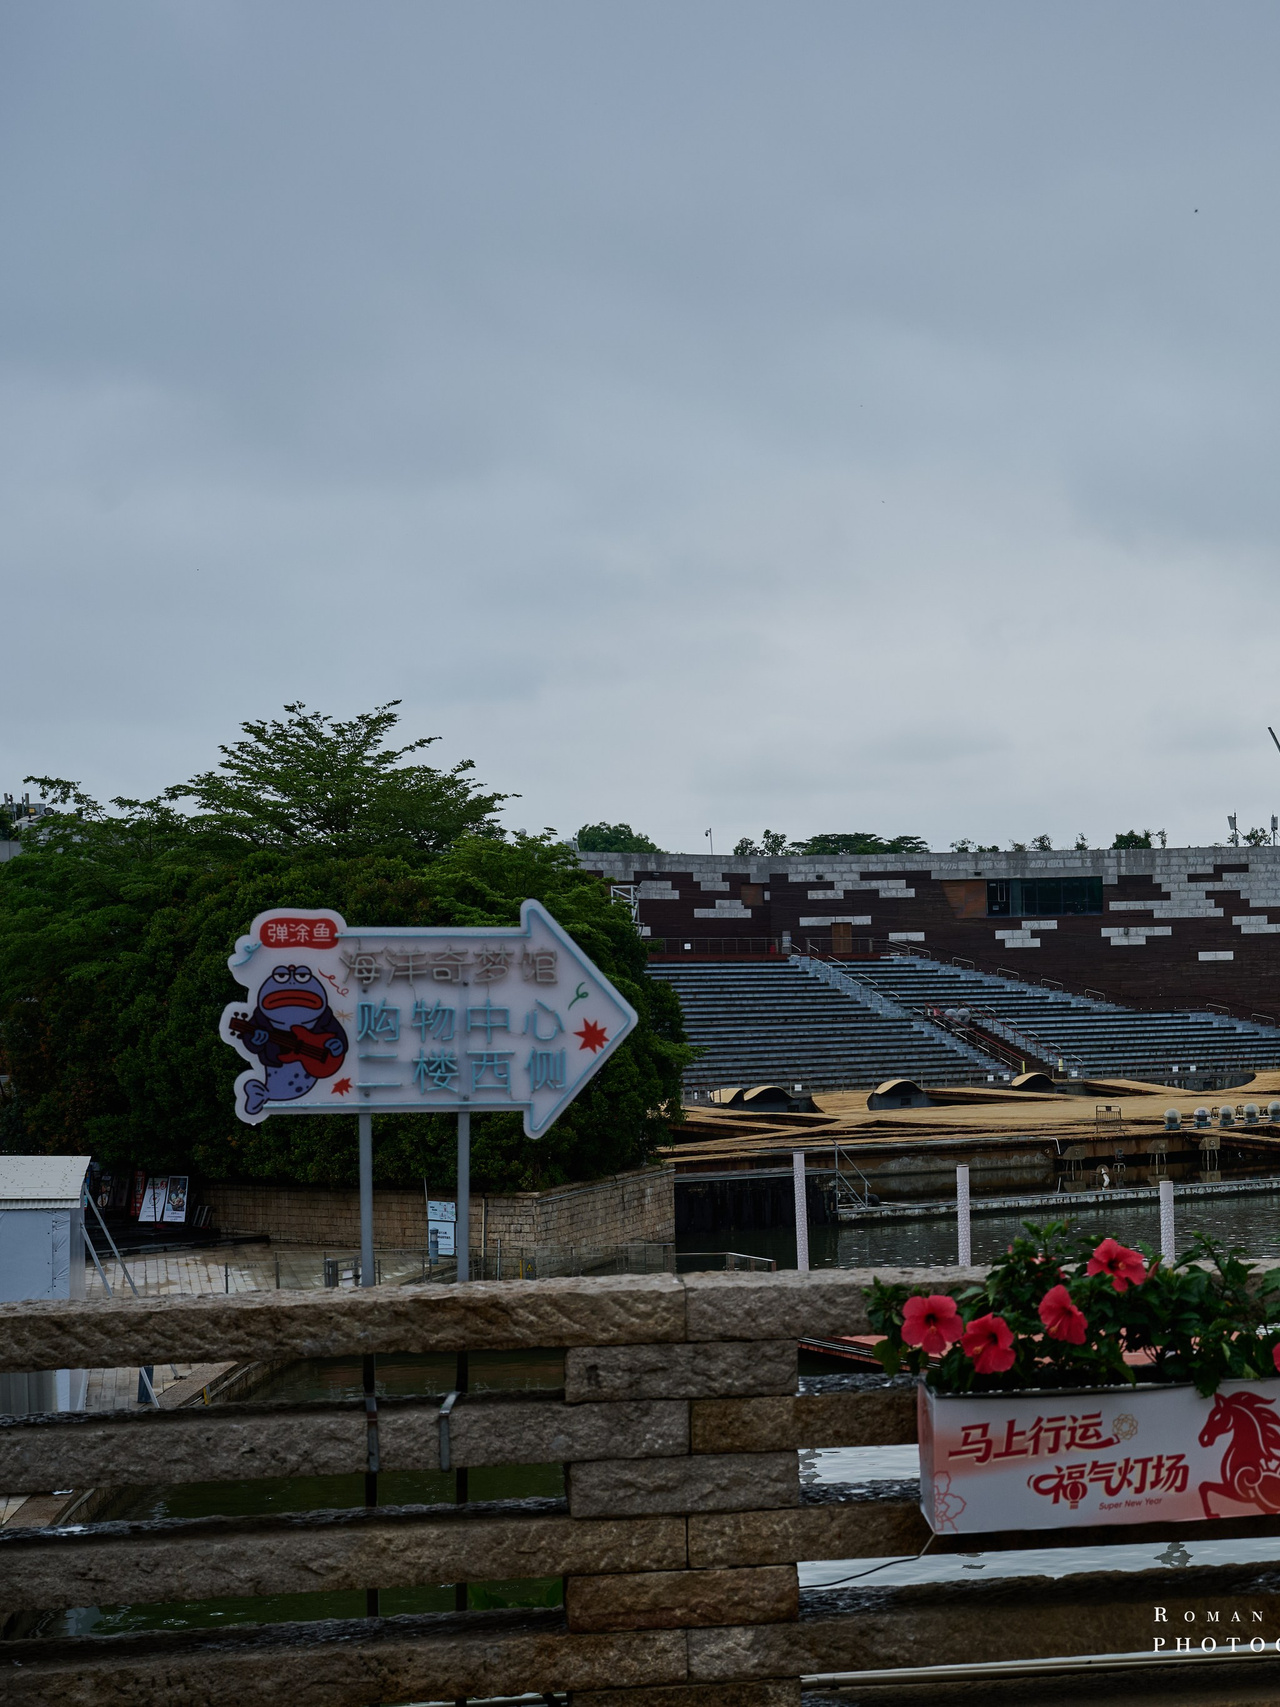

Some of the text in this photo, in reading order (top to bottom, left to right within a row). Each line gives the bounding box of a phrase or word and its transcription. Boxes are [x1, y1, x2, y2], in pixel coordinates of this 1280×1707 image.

[268, 923, 331, 942] 弹涂鱼
[341, 945, 559, 985] 海洋奇梦馆
[357, 998, 566, 1043] 购物中心
[355, 1048, 566, 1093] 二楼西侧
[948, 1410, 1119, 1464] 马上行运
[1027, 1454, 1190, 1509] 福气灯场
[1099, 1497, 1162, 1511] Super New Year
